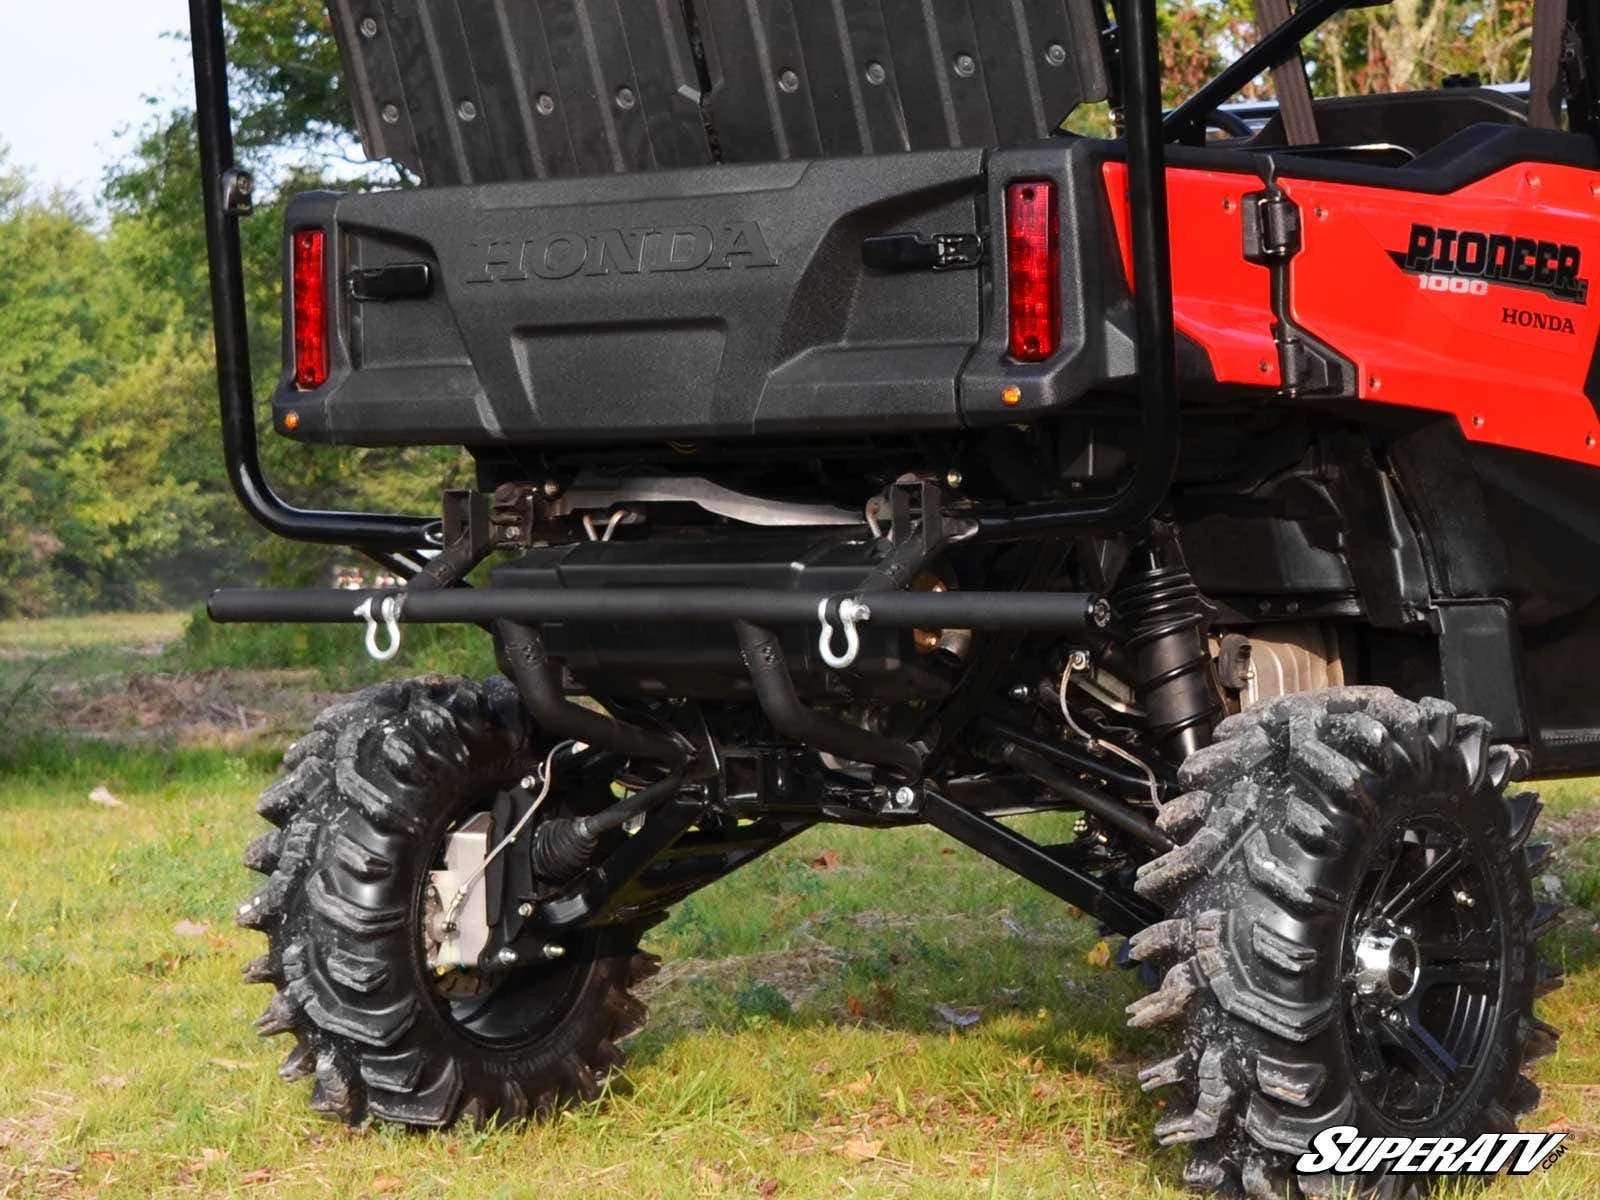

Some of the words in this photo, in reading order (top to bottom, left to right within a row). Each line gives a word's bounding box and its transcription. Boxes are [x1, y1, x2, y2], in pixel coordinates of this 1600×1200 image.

[465, 219, 780, 284] HONDA
[1406, 223, 1582, 290] PIONEER
[1418, 274, 1488, 295] 1000
[1502, 307, 1576, 334] HONDA
